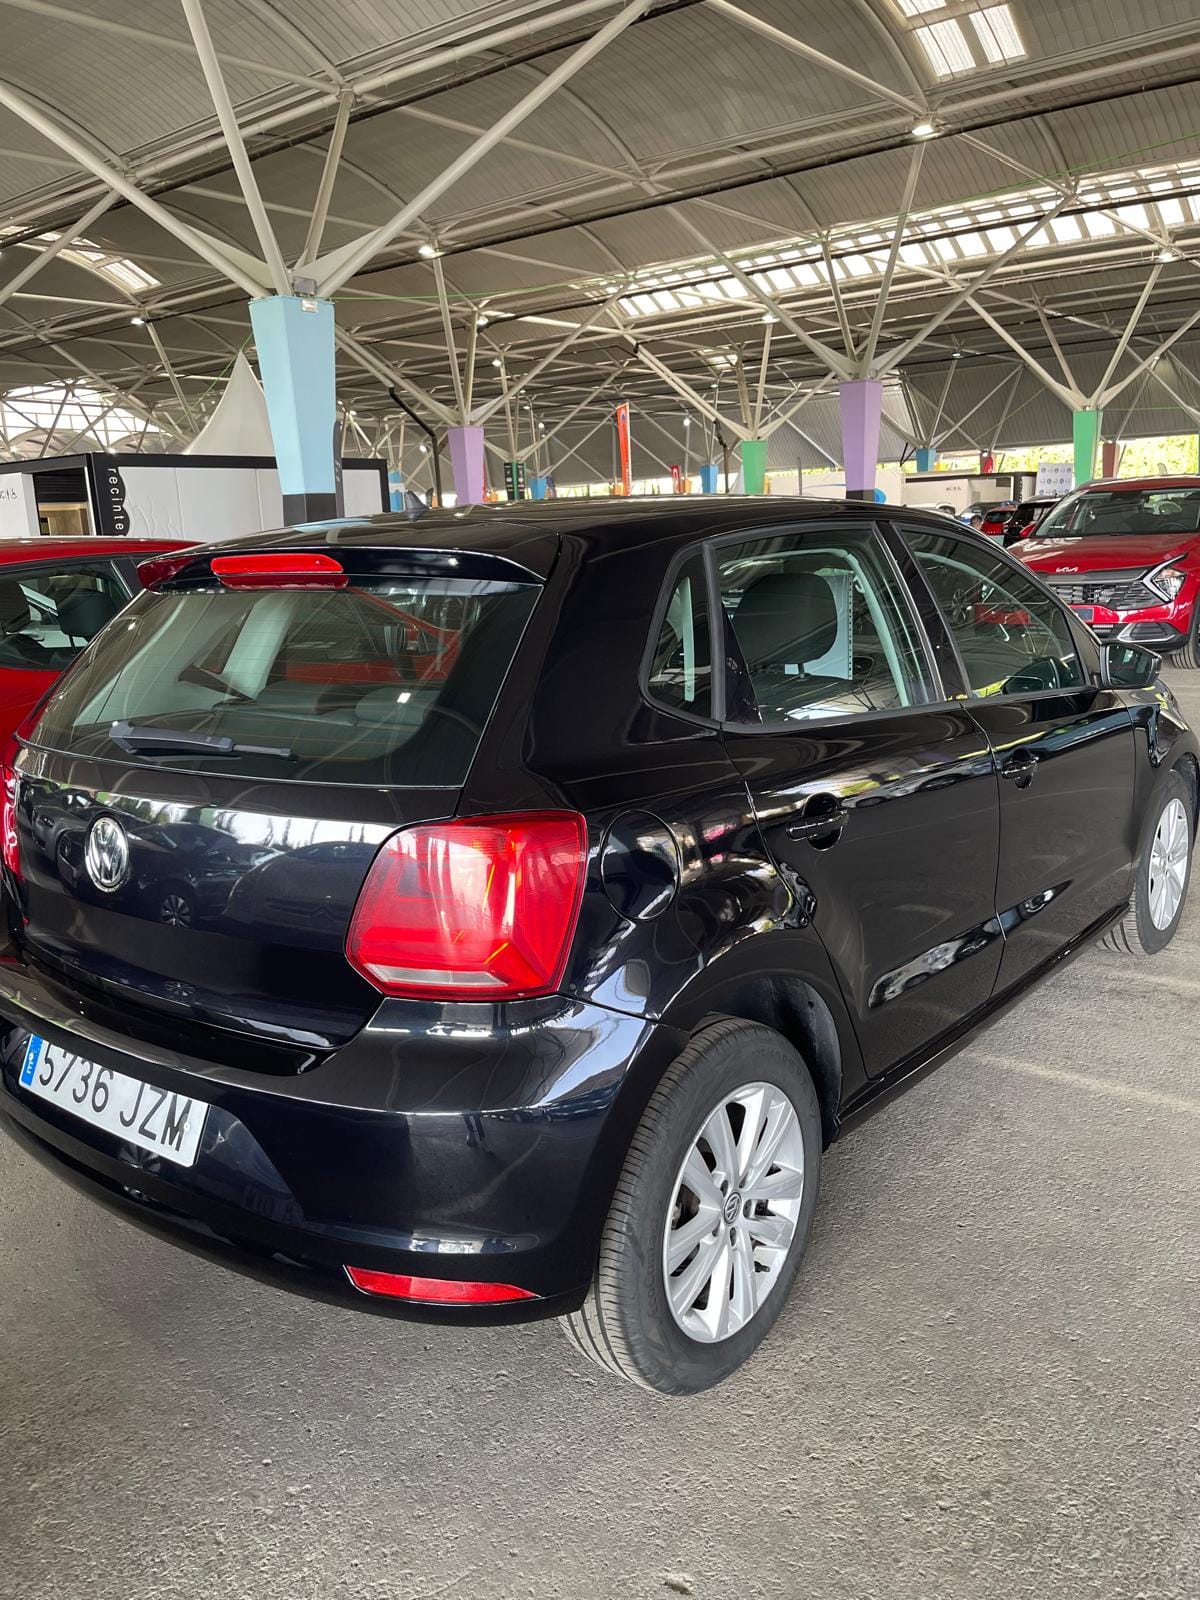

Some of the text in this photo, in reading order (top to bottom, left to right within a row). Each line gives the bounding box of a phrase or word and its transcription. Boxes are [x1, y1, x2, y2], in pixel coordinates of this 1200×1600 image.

[108, 468, 125, 536] recinte
[39, 1042, 193, 1152] 5736 JZM
